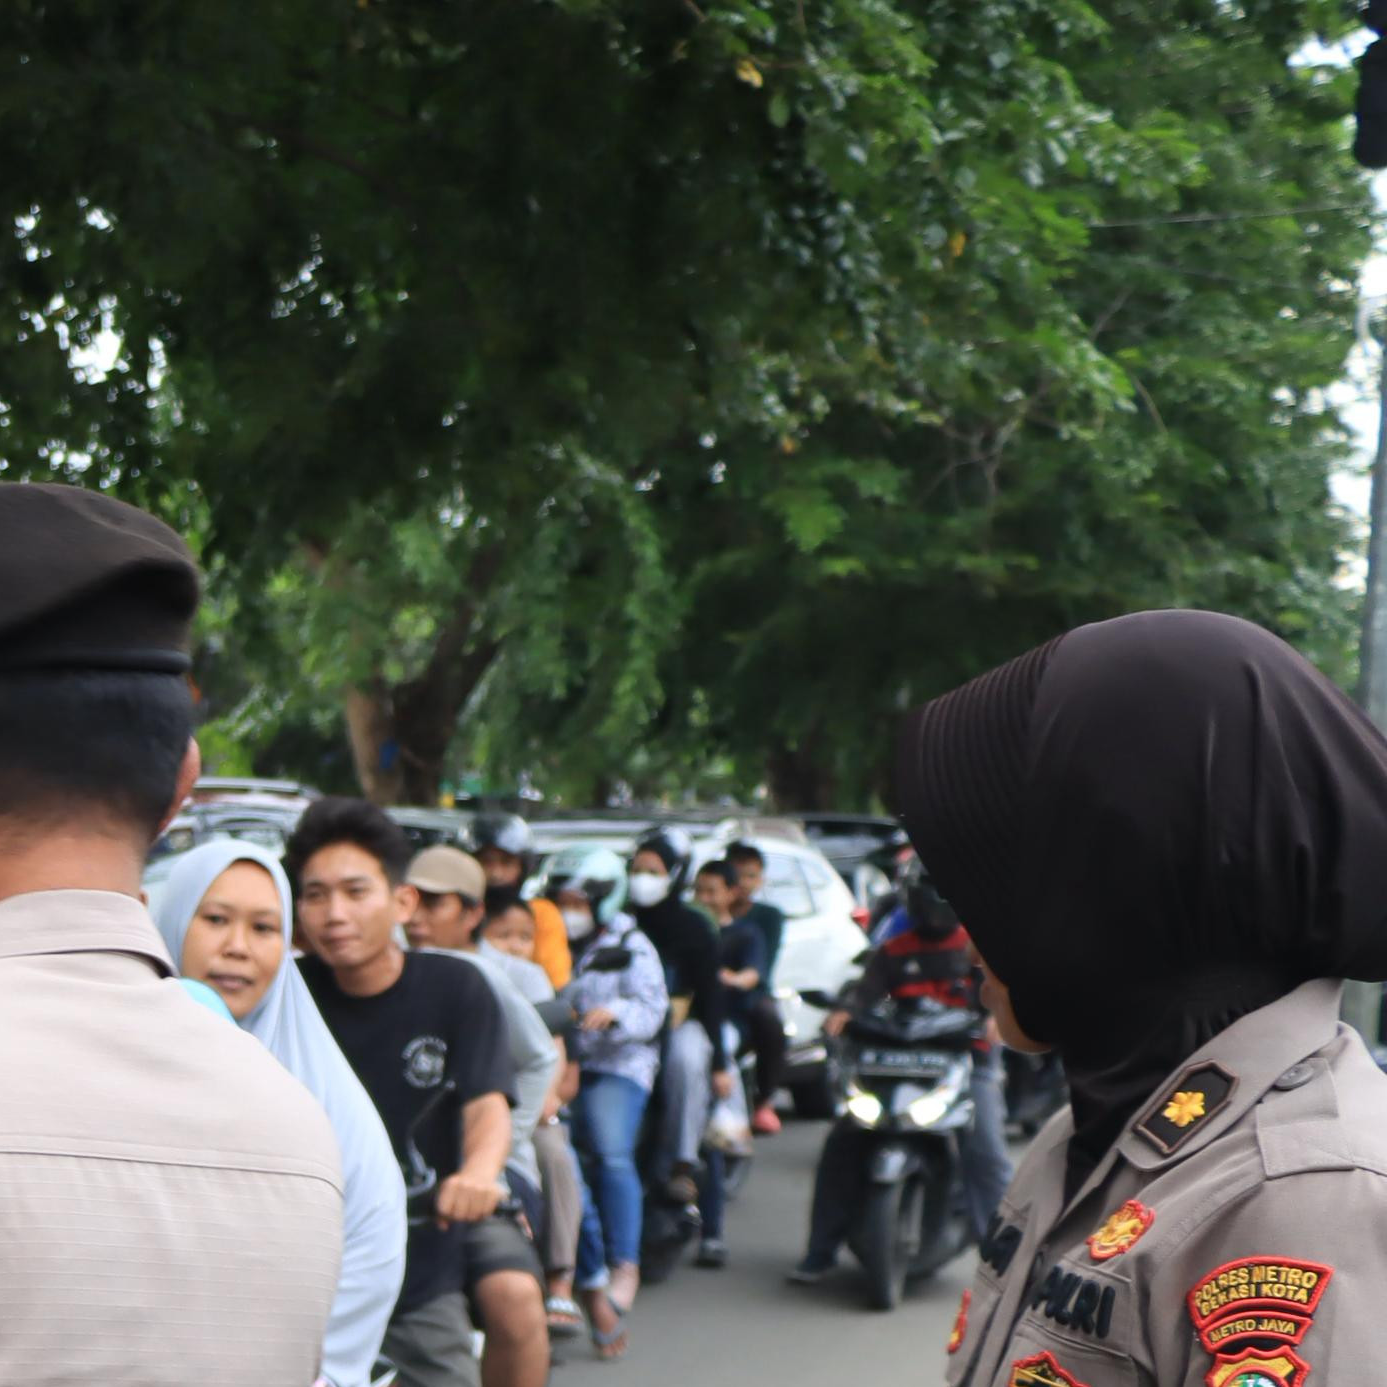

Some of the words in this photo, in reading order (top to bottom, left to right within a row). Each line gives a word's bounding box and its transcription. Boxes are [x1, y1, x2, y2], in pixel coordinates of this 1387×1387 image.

[1195, 1267, 1250, 1307] POLRES
[1251, 1265, 1318, 1289] METRO
[1260, 1283, 1309, 1304] KOTA
[1209, 1318, 1256, 1342] METRO
[1258, 1319, 1295, 1335] JAYA
